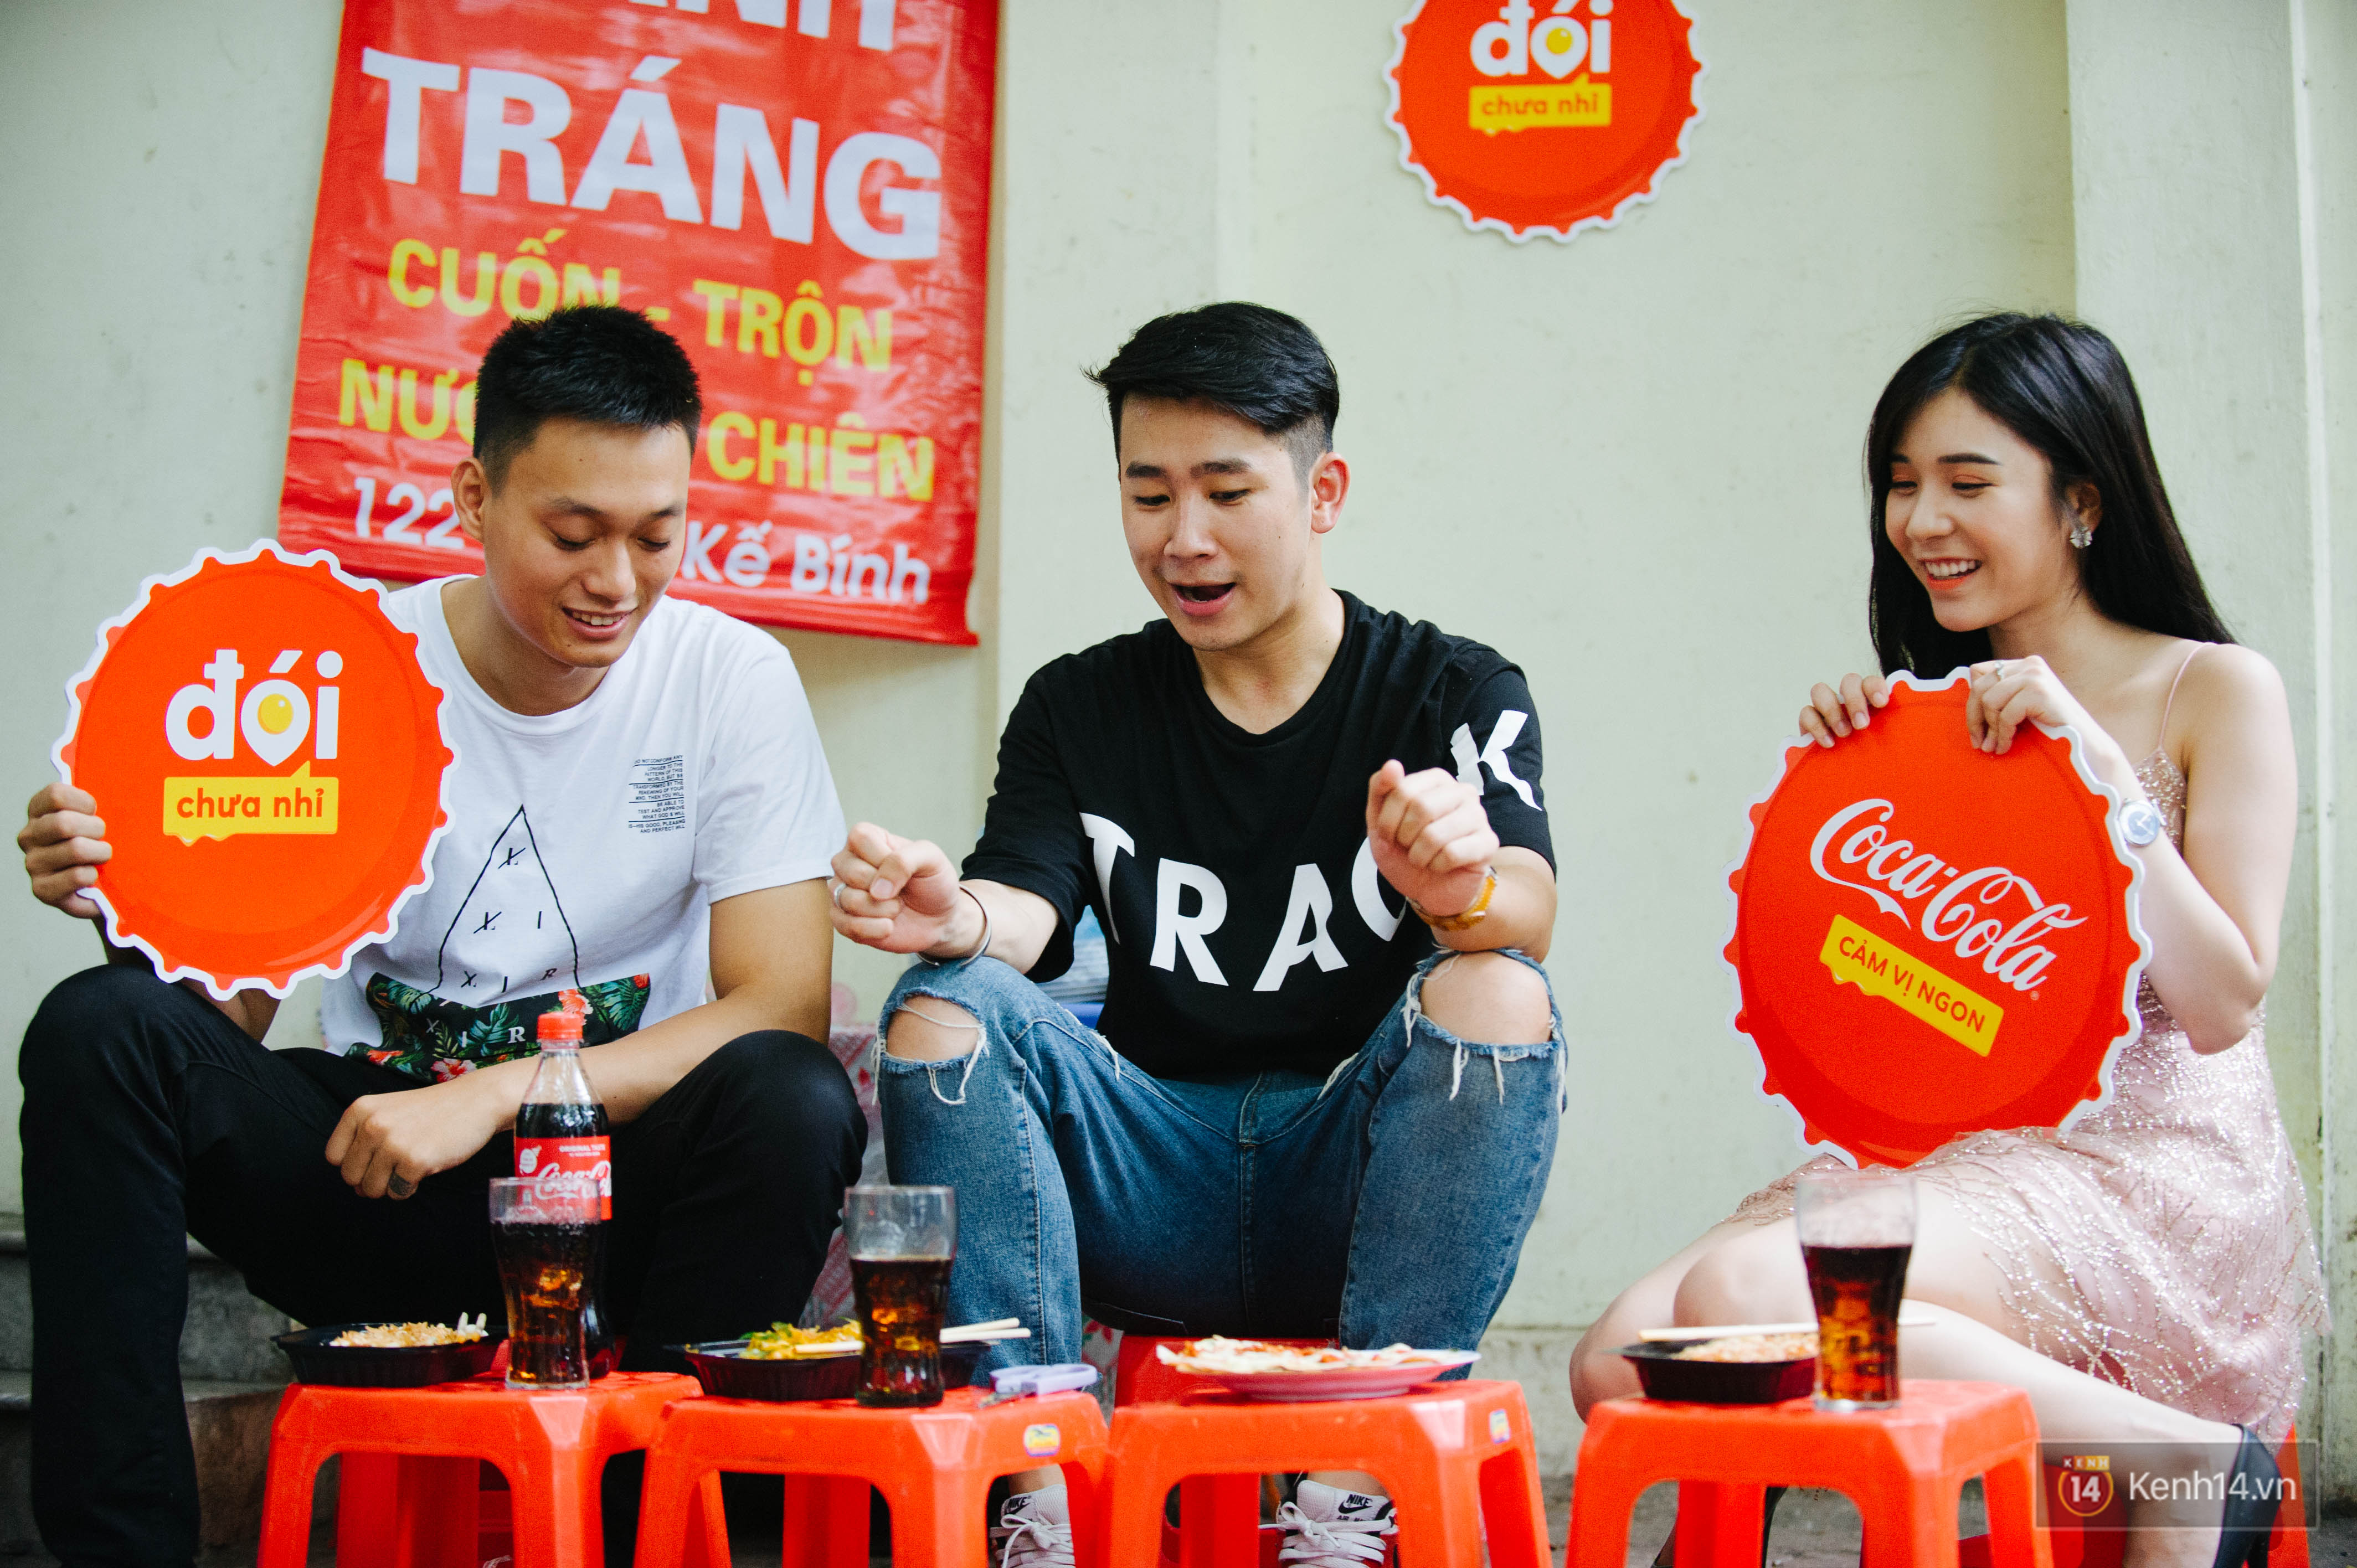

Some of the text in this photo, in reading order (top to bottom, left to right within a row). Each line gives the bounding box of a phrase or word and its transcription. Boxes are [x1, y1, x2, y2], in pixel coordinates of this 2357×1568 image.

[1482, 95, 1548, 116] chưa
[362, 47, 943, 261] TRÁNG
[389, 228, 620, 321] CUỐN
[693, 280, 892, 386] TRỘN
[706, 412, 935, 502] CHIÊN
[681, 520, 773, 588] Kế
[791, 533, 931, 604] Bính
[165, 649, 343, 767] đói
[177, 787, 325, 819] chưa nhỉ
[1810, 798, 2088, 991] Coca-Cola
[1839, 936, 1986, 1034] CẢM VỊ NGON
[1346, 1494, 1371, 1507] NIKE
